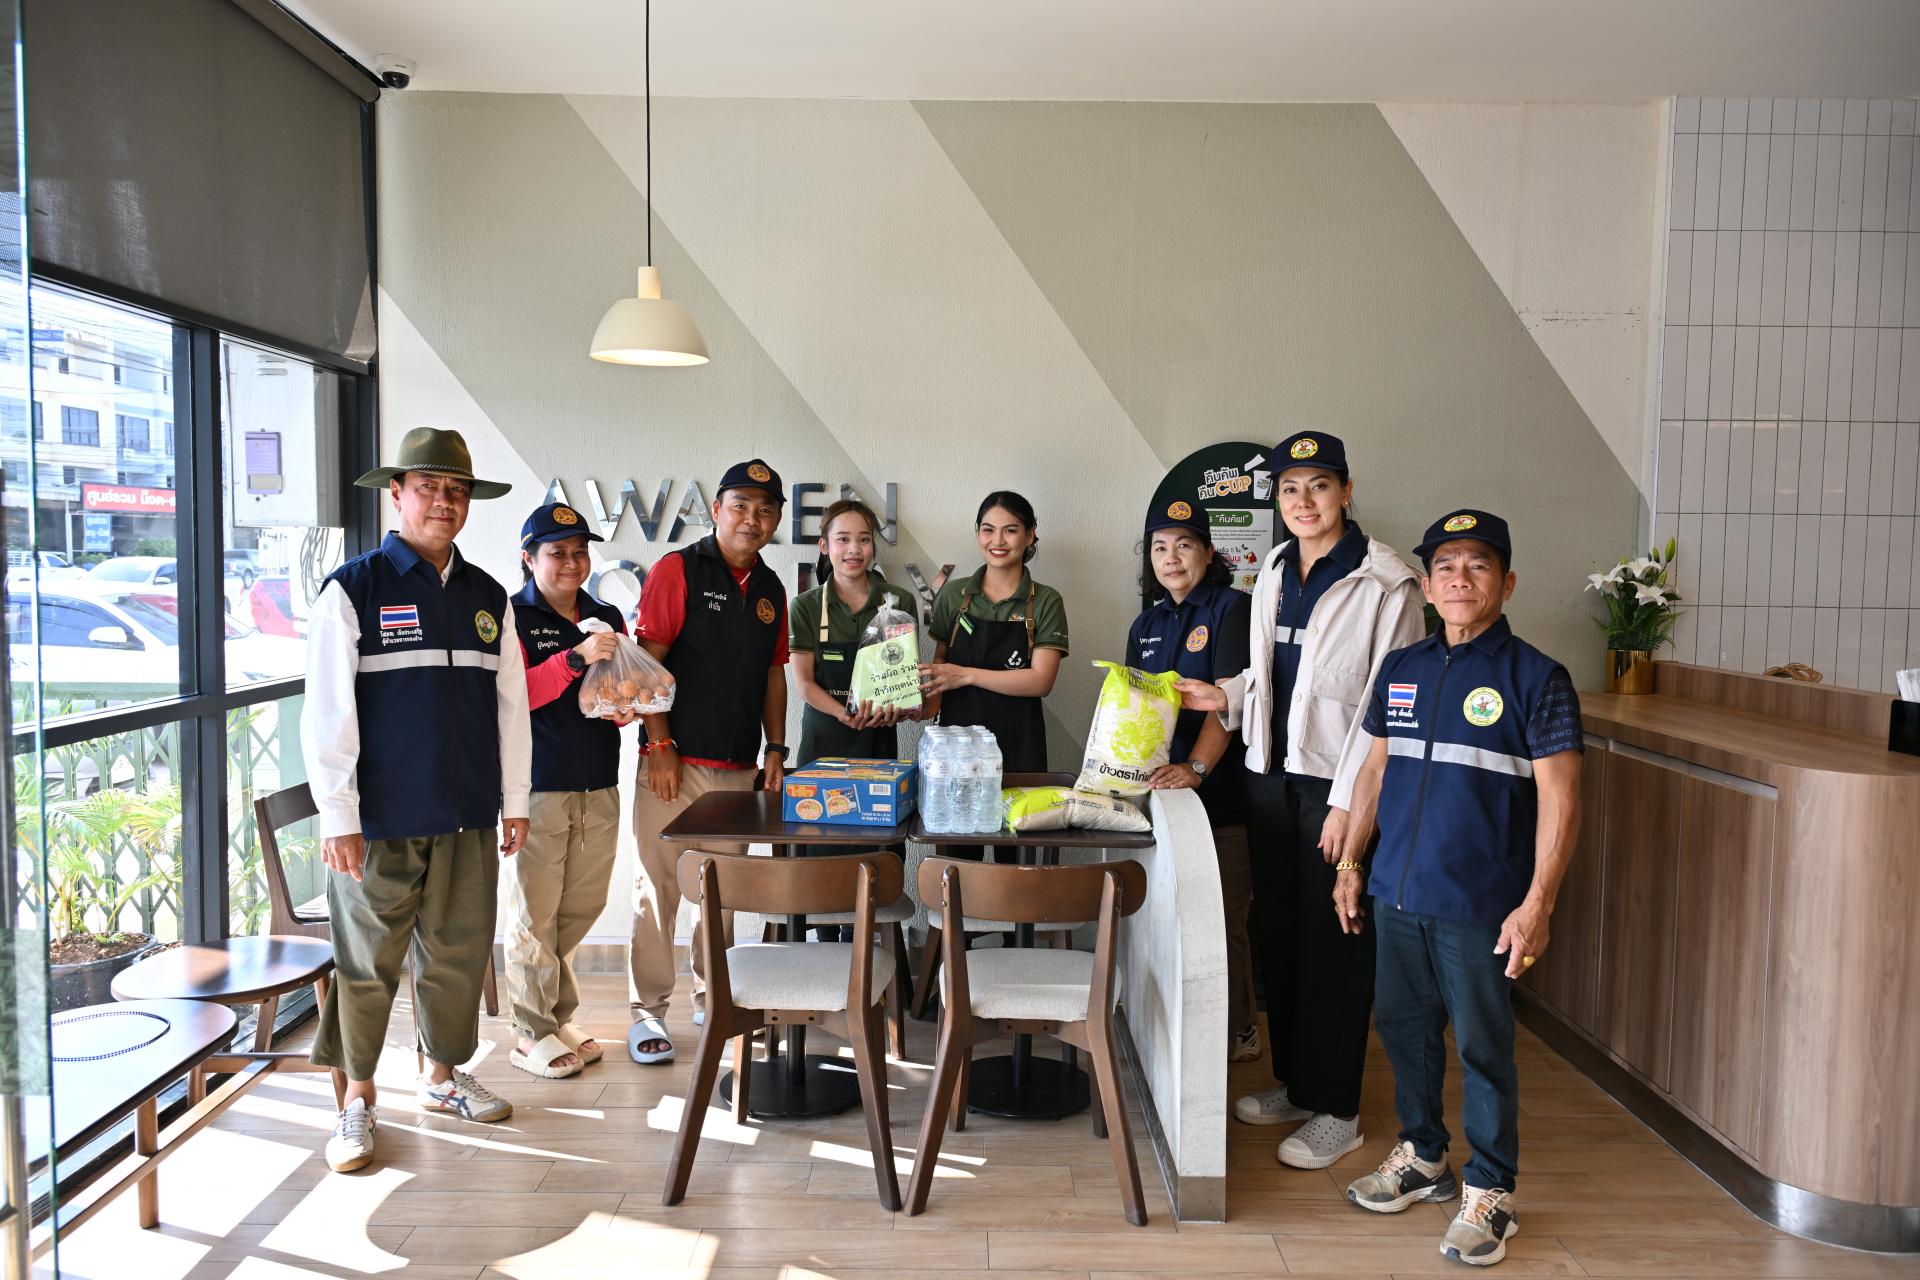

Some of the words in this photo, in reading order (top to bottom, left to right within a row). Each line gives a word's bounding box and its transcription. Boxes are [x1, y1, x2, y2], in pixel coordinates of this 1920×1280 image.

[1199, 486, 1216, 499] คืน
[1215, 476, 1251, 496] CUP
[1205, 468, 1239, 484] คืนคัพ
[541, 478, 898, 545] AWAEN
